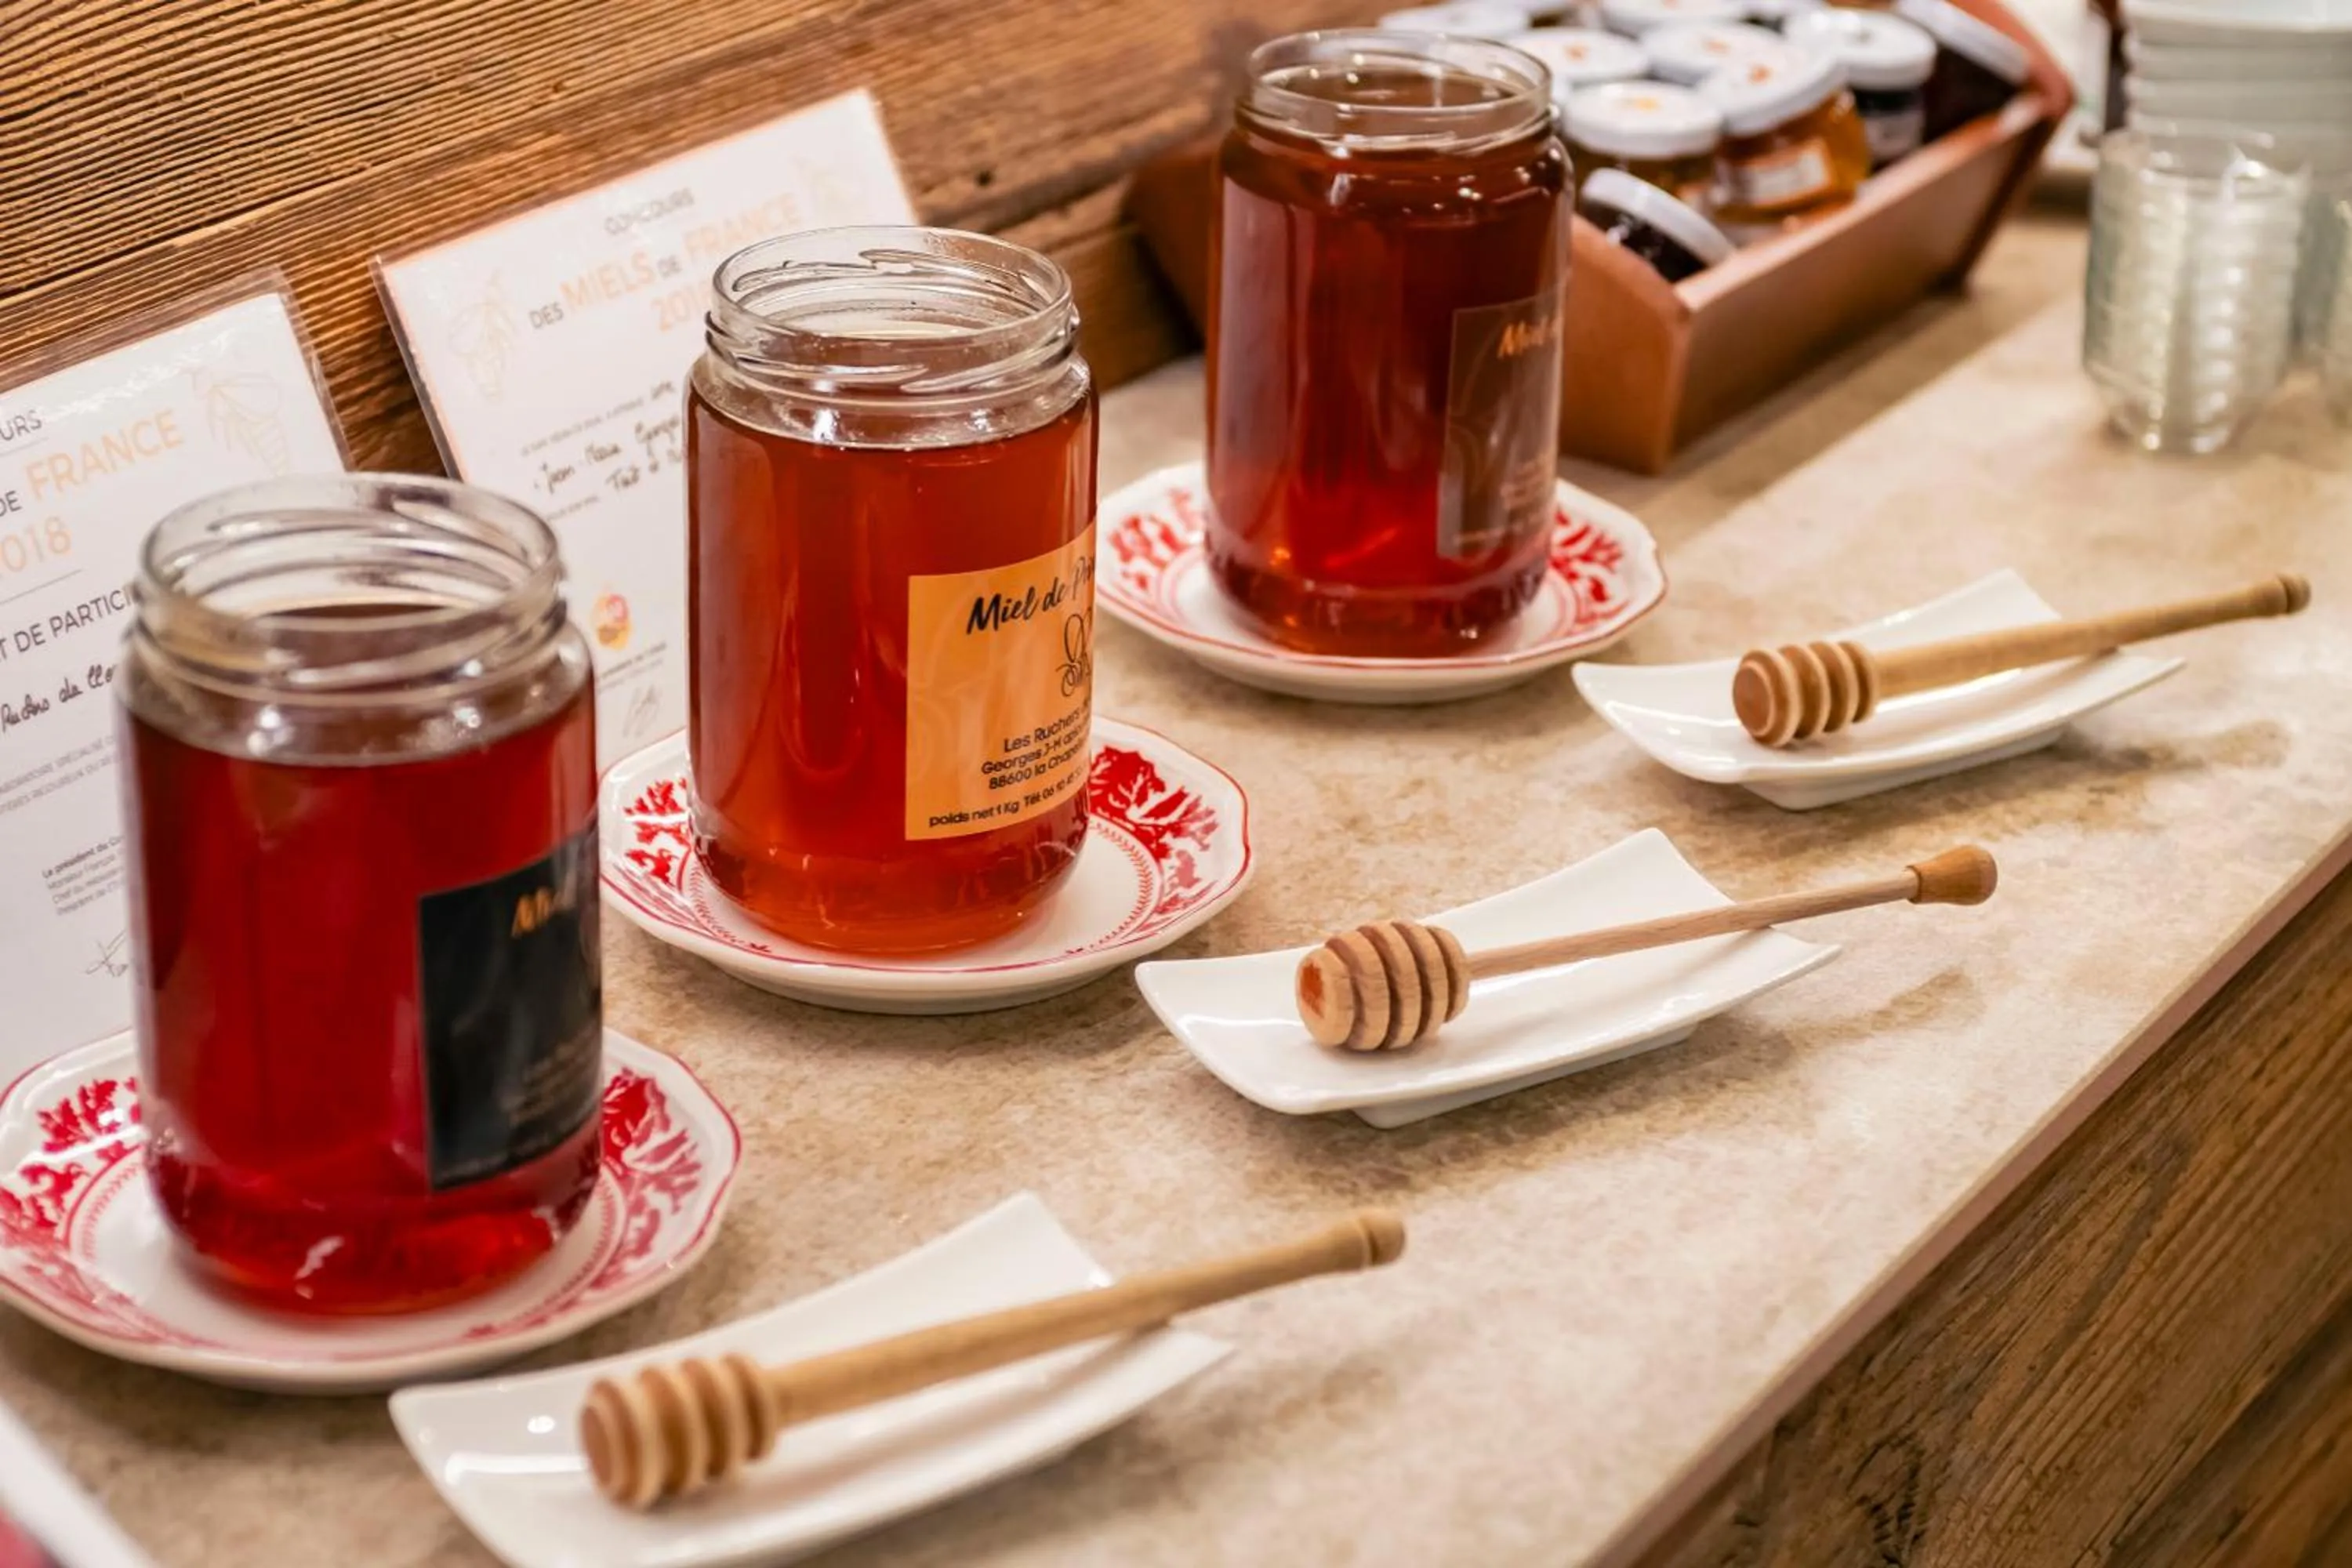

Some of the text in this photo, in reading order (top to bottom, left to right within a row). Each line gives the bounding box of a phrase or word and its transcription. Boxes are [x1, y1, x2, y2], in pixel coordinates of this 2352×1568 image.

[528, 301, 564, 329] DES
[559, 250, 655, 311] MIELS
[682, 191, 800, 263] FRANCE
[25, 408, 186, 502] FRANCE
[0, 516, 72, 578] 018
[966, 585, 1039, 636] Miel
[1042, 576, 1067, 613] de
[13, 623, 45, 653] DE
[1004, 707, 1080, 753] Les Ruchers
[981, 748, 1043, 775] Georges
[989, 767, 1033, 790] 88600
[1034, 763, 1047, 776] la
[928, 811, 970, 829] poids
[971, 806, 995, 821] net
[1004, 800, 1020, 815] Kg
